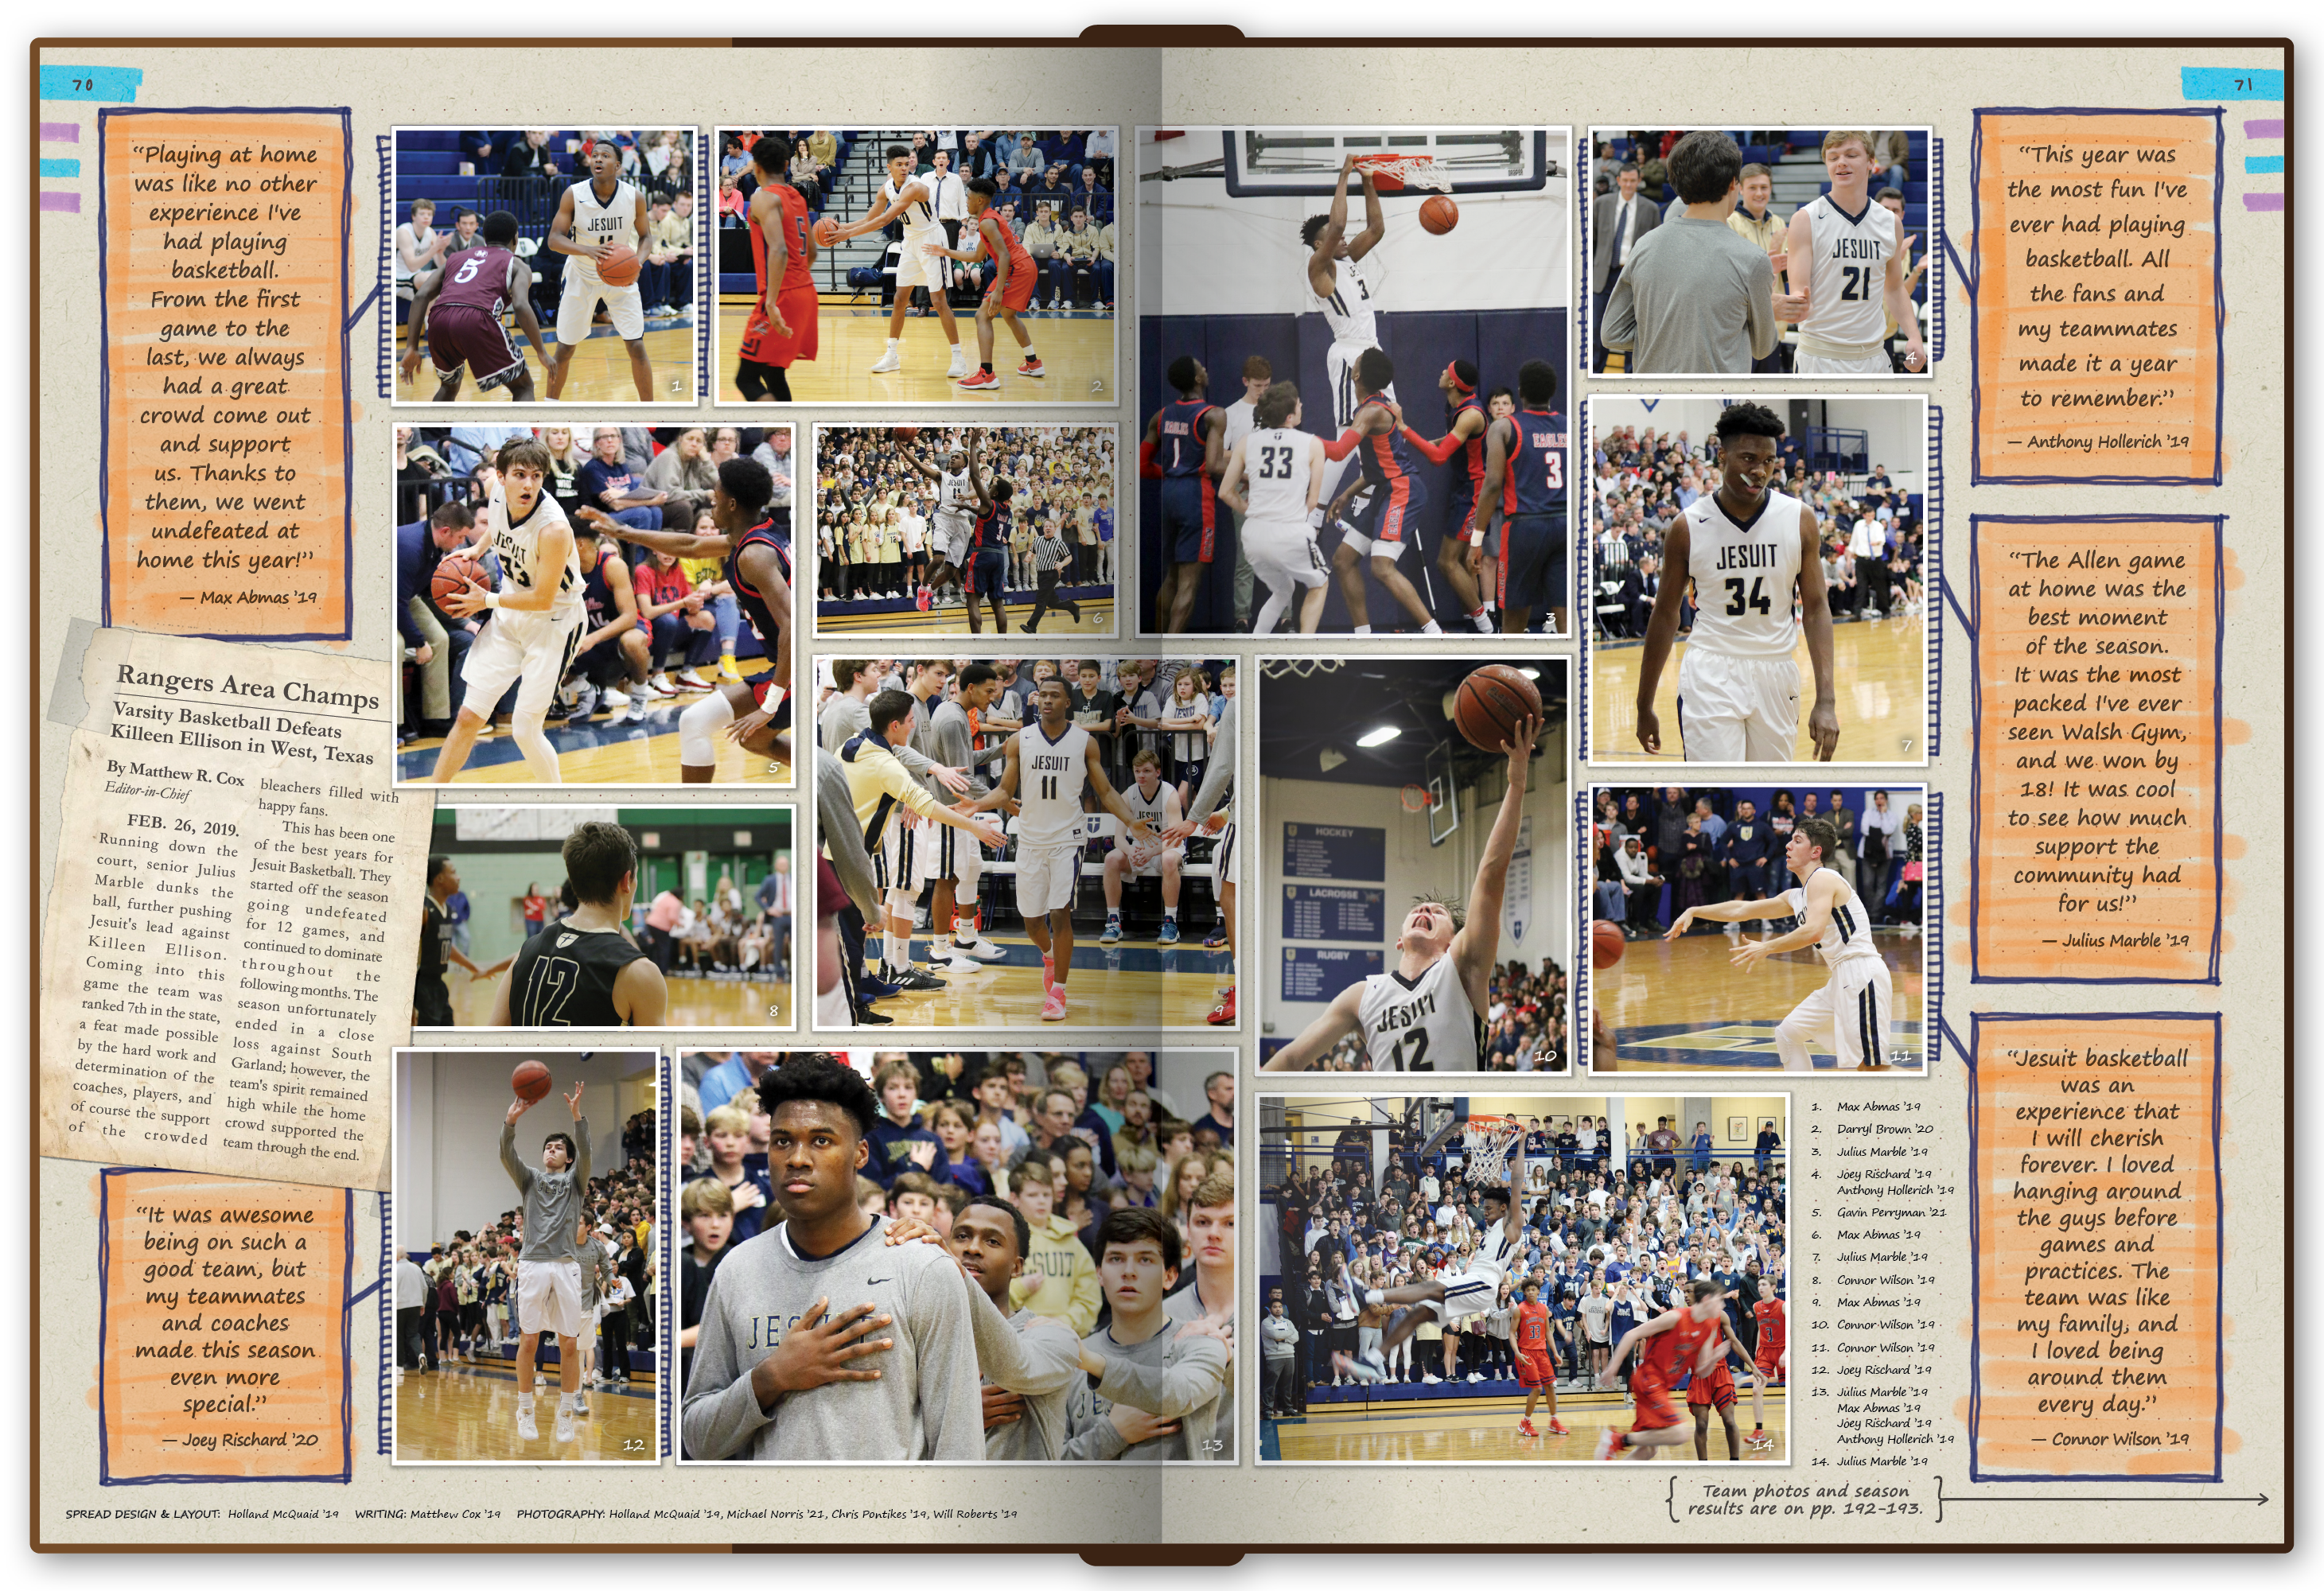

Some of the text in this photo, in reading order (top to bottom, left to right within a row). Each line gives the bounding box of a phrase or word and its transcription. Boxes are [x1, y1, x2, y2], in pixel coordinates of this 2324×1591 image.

[72, 79, 93, 91] 70
[2234, 78, 2252, 91] 71
[134, 144, 317, 169] “Playing at home
[2019, 145, 2175, 168] “This year was
[588, 216, 623, 231] JESUIT
[795, 216, 807, 256] 5
[1832, 239, 1880, 260] JESUIT
[454, 257, 486, 284] 5
[1357, 278, 1369, 301] 3
[1841, 266, 1870, 301] 21
[2019, 321, 2177, 342] my teammates
[141, 405, 311, 423] crowd come out
[1164, 420, 1189, 436] EAGLES
[1173, 438, 1180, 469] 1
[1259, 446, 1293, 479] 33
[1545, 451, 1563, 488] 3
[1717, 544, 1777, 570] JESUIT
[2010, 550, 2185, 574] “The Allen game
[1725, 576, 1771, 616] 34
[116, 664, 379, 714] Rangers Area Champs
[114, 701, 341, 738] Varsity Basketball Defeats
[111, 723, 373, 764] Killeen Ellison in West, Texas
[2008, 722, 2186, 745] seen Walsh Gym,
[107, 760, 244, 786] By Matthew R. Cox
[1031, 755, 1070, 772] JESUIT
[106, 781, 189, 803] Editor-in-Chief
[261, 778, 399, 803] bleachers filled with
[1041, 776, 1057, 800] 11
[127, 814, 239, 837] FEB. 26, 2019.
[1315, 827, 1353, 838] HOCKEY
[99, 833, 237, 857] Running down the
[1310, 888, 1358, 900] LACROSSE
[89, 936, 226, 960] Killeen Ellison.
[1317, 951, 1350, 961] RUGBY
[523, 955, 580, 1026] 12
[1392, 1027, 1434, 1072] 12
[2008, 1048, 2188, 1067] “Jesuit basketball
[1838, 1123, 1872, 1136] Darryl
[1877, 1125, 1911, 1134] Brown
[1837, 1184, 1883, 1197] Anthony
[1888, 1184, 1933, 1195] Hollerich
[2025, 1261, 2169, 1286] practices. The
[162, 1313, 288, 1331] and coaches
[1529, 1325, 1541, 1339] 33
[1765, 1327, 1773, 1342] 3
[136, 1340, 315, 1358] made this season
[1703, 1483, 1909, 1502] Team photos and season
[115, 1510, 156, 1519] DESIGN
[174, 1510, 220, 1519] LAYOUT:
[229, 1509, 268, 1519] Holland
[274, 1510, 318, 1519] McQuaid
[1689, 1501, 1922, 1519] results are on pp. 192-193.
